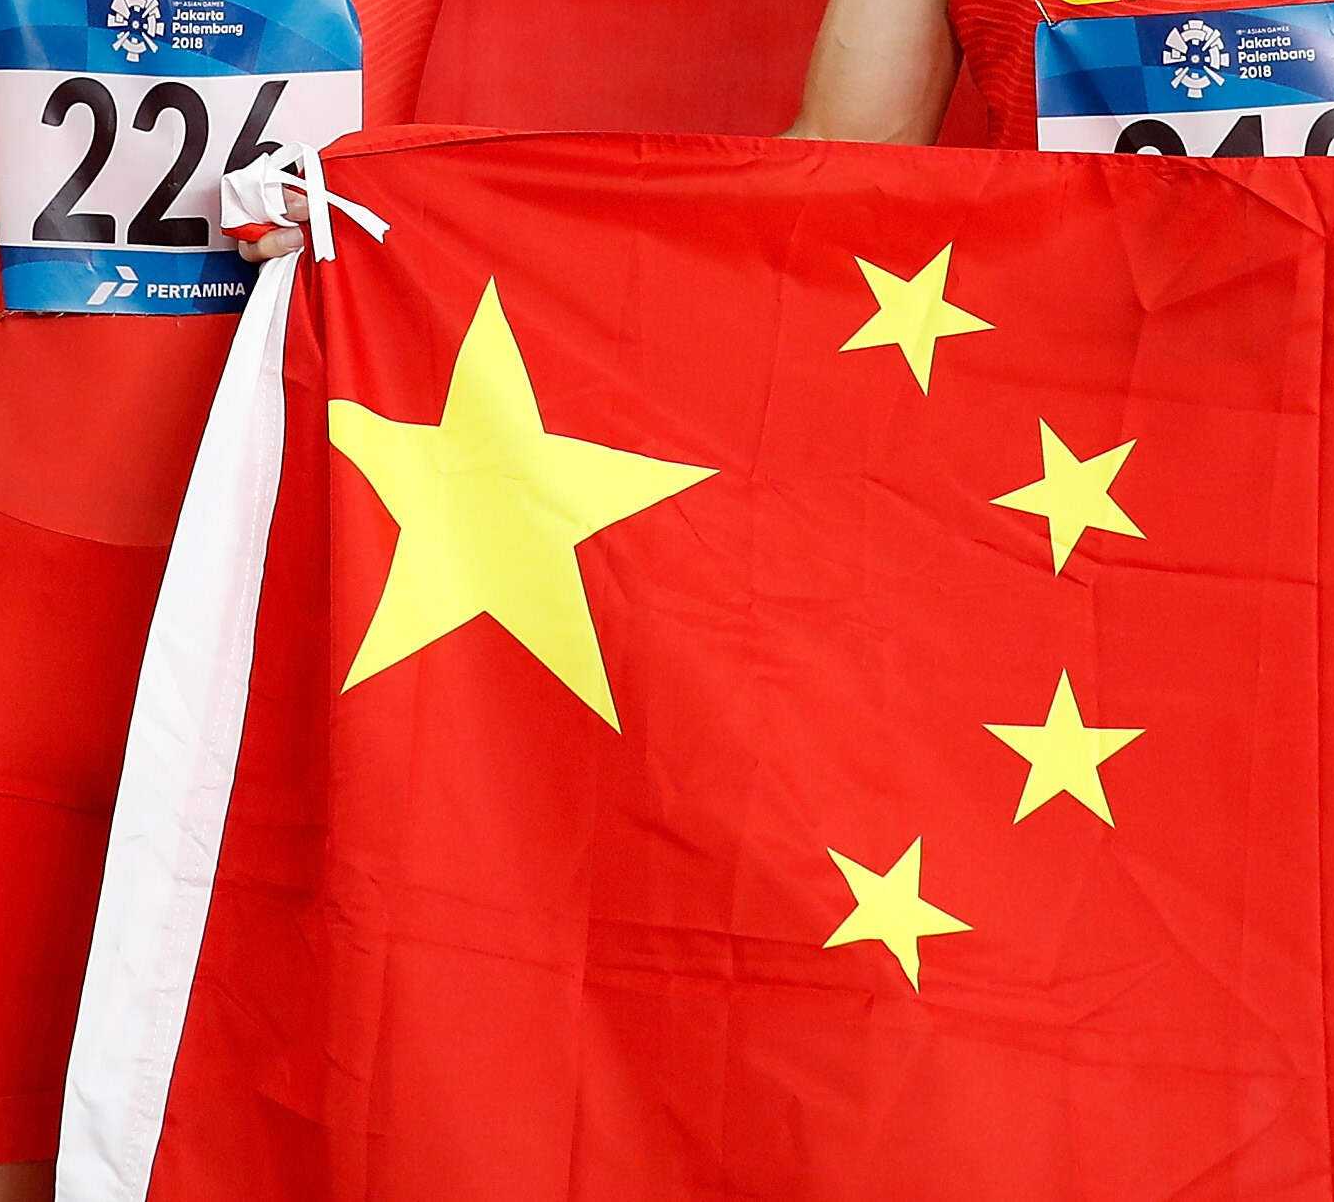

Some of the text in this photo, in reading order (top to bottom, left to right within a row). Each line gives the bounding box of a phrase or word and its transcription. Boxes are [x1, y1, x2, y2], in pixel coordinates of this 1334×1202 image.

[172, 8, 224, 20] Jakarta
[172, 22, 243, 36] Palembang
[172, 37, 203, 49] 2018
[1237, 35, 1291, 49] Jakarta
[1237, 48, 1315, 64] Palembang
[1239, 65, 1272, 79] 2018
[146, 282, 247, 298] PERTAMINA
